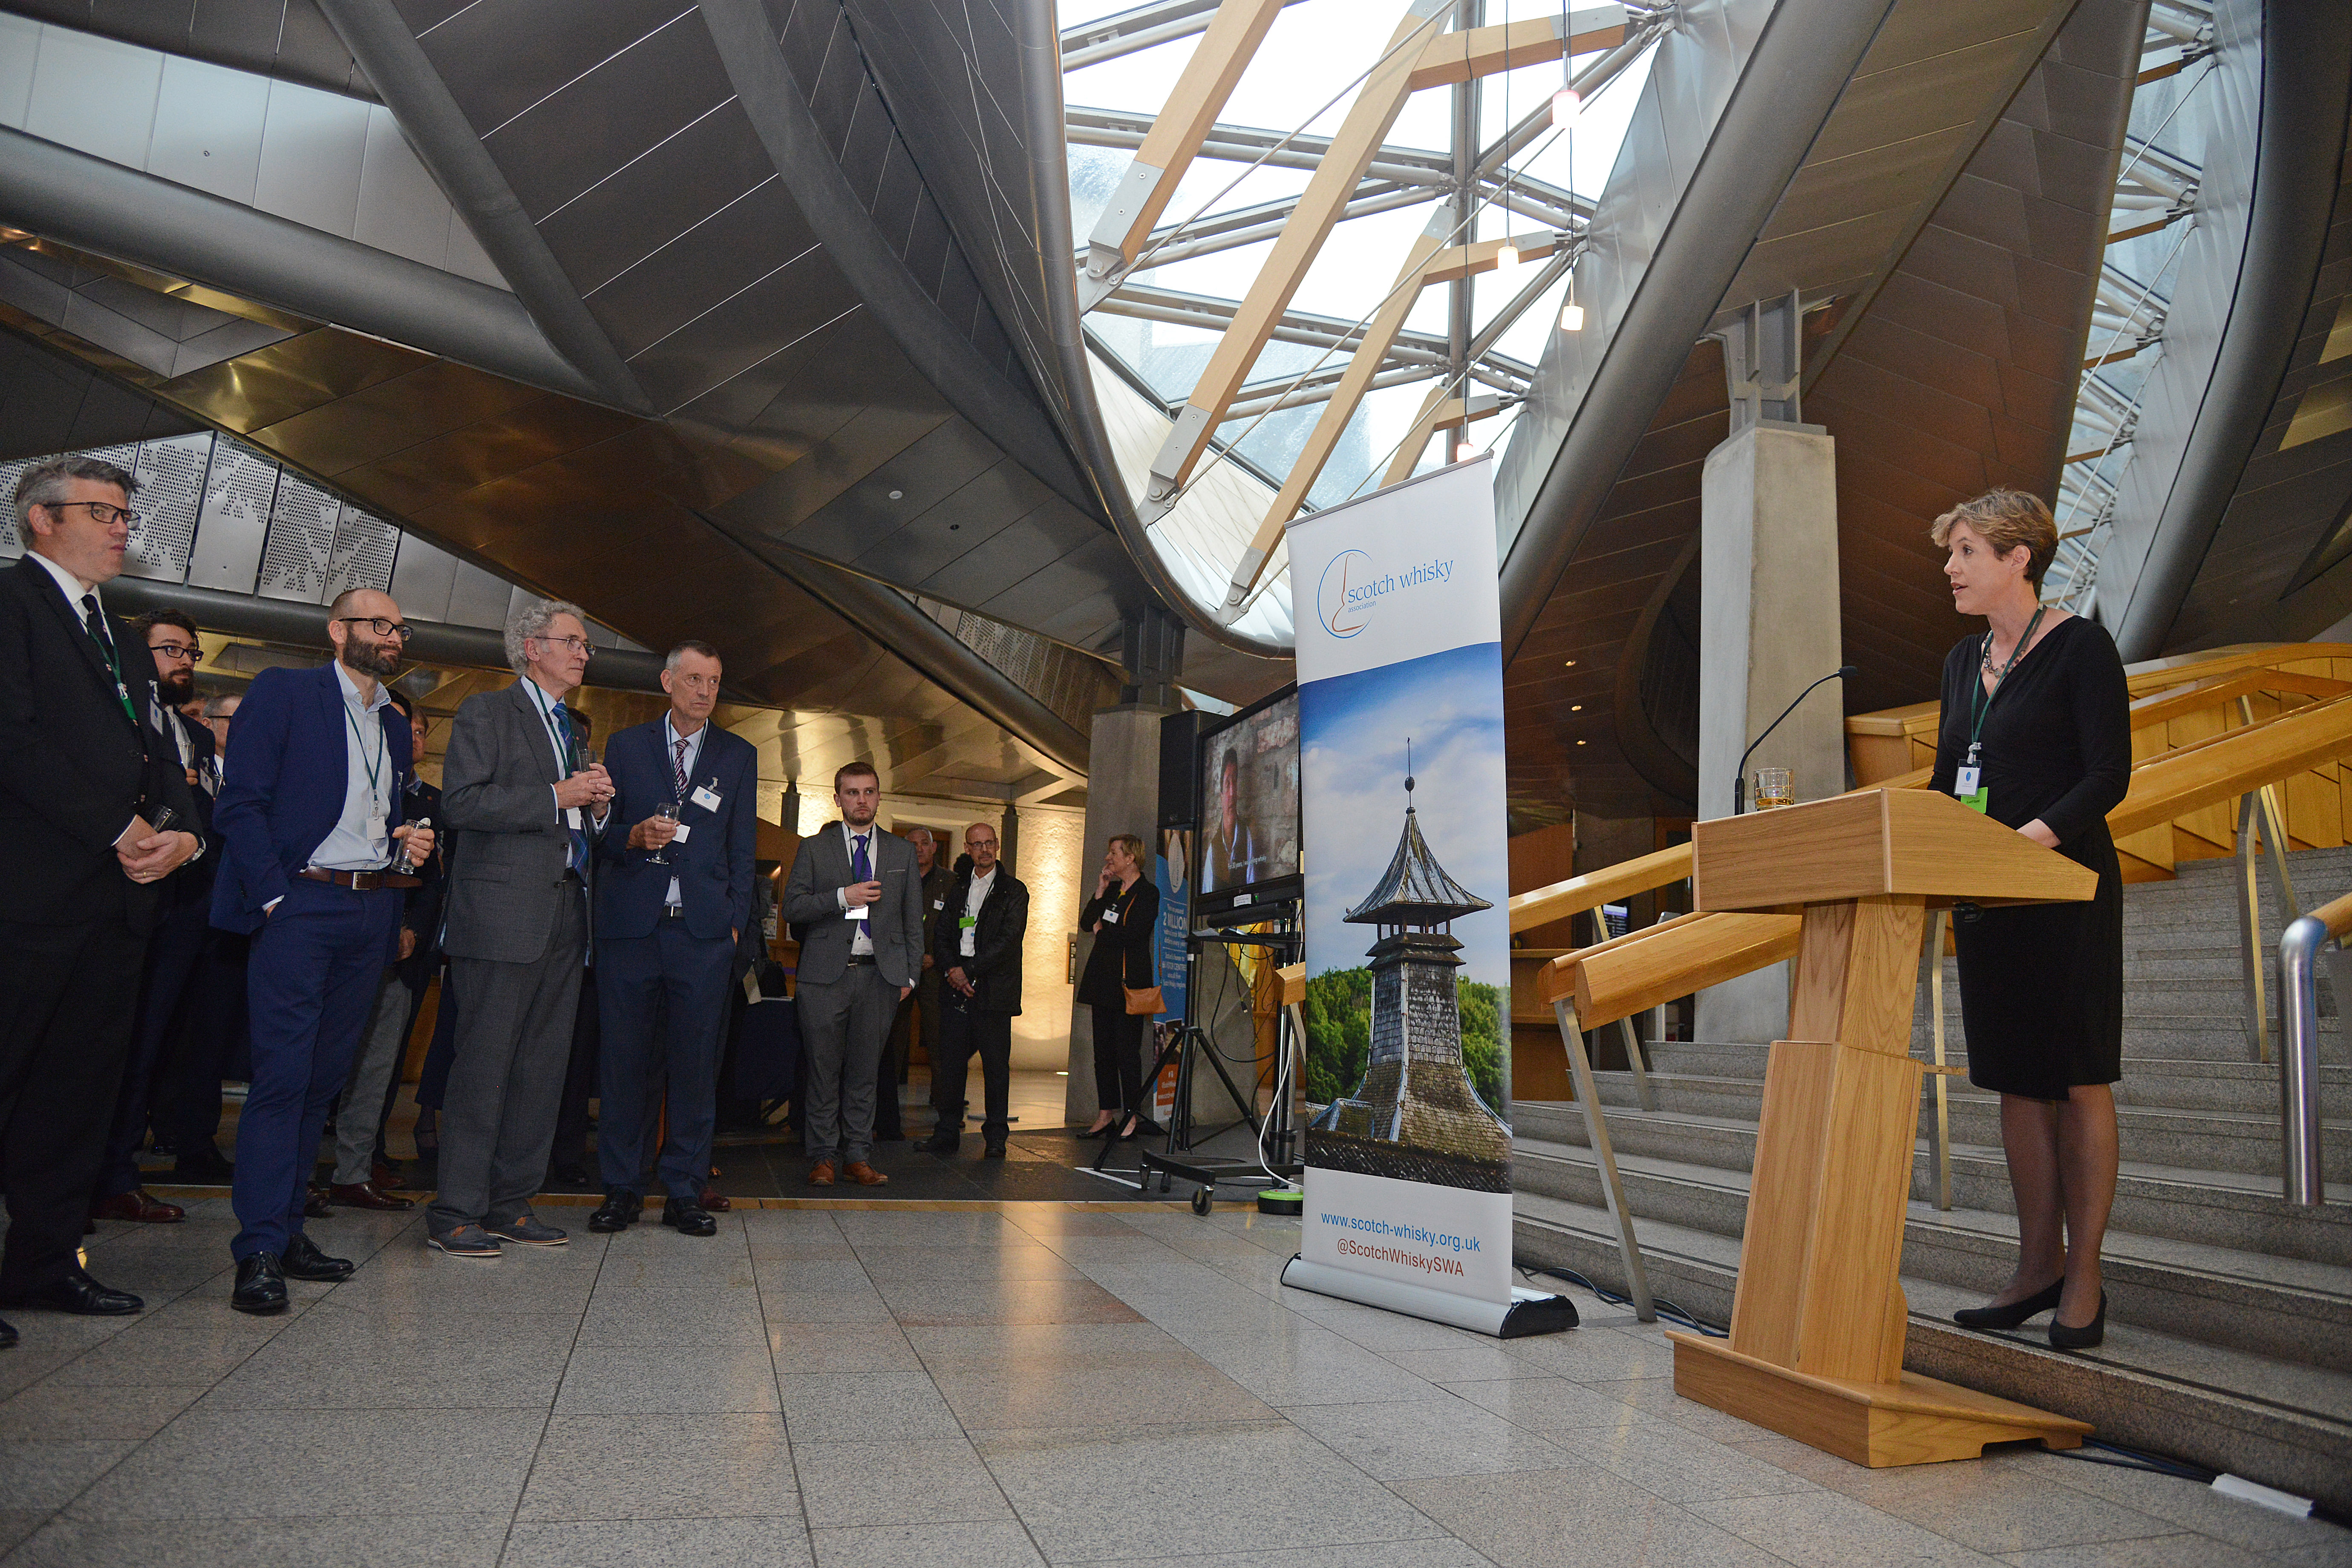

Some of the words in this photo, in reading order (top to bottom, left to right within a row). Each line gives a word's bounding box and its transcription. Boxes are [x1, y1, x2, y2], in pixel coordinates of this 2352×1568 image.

[1348, 574, 1395, 603] scotch
[1399, 559, 1454, 589] whisky
[1348, 600, 1376, 613] association
[1163, 912, 1167, 925] 2
[1168, 913, 1187, 931] MILLION
[1321, 1213, 1480, 1252] www.scotch-whisky.org.uk
[1337, 1239, 1464, 1277] @ScotchWhiskySWA
